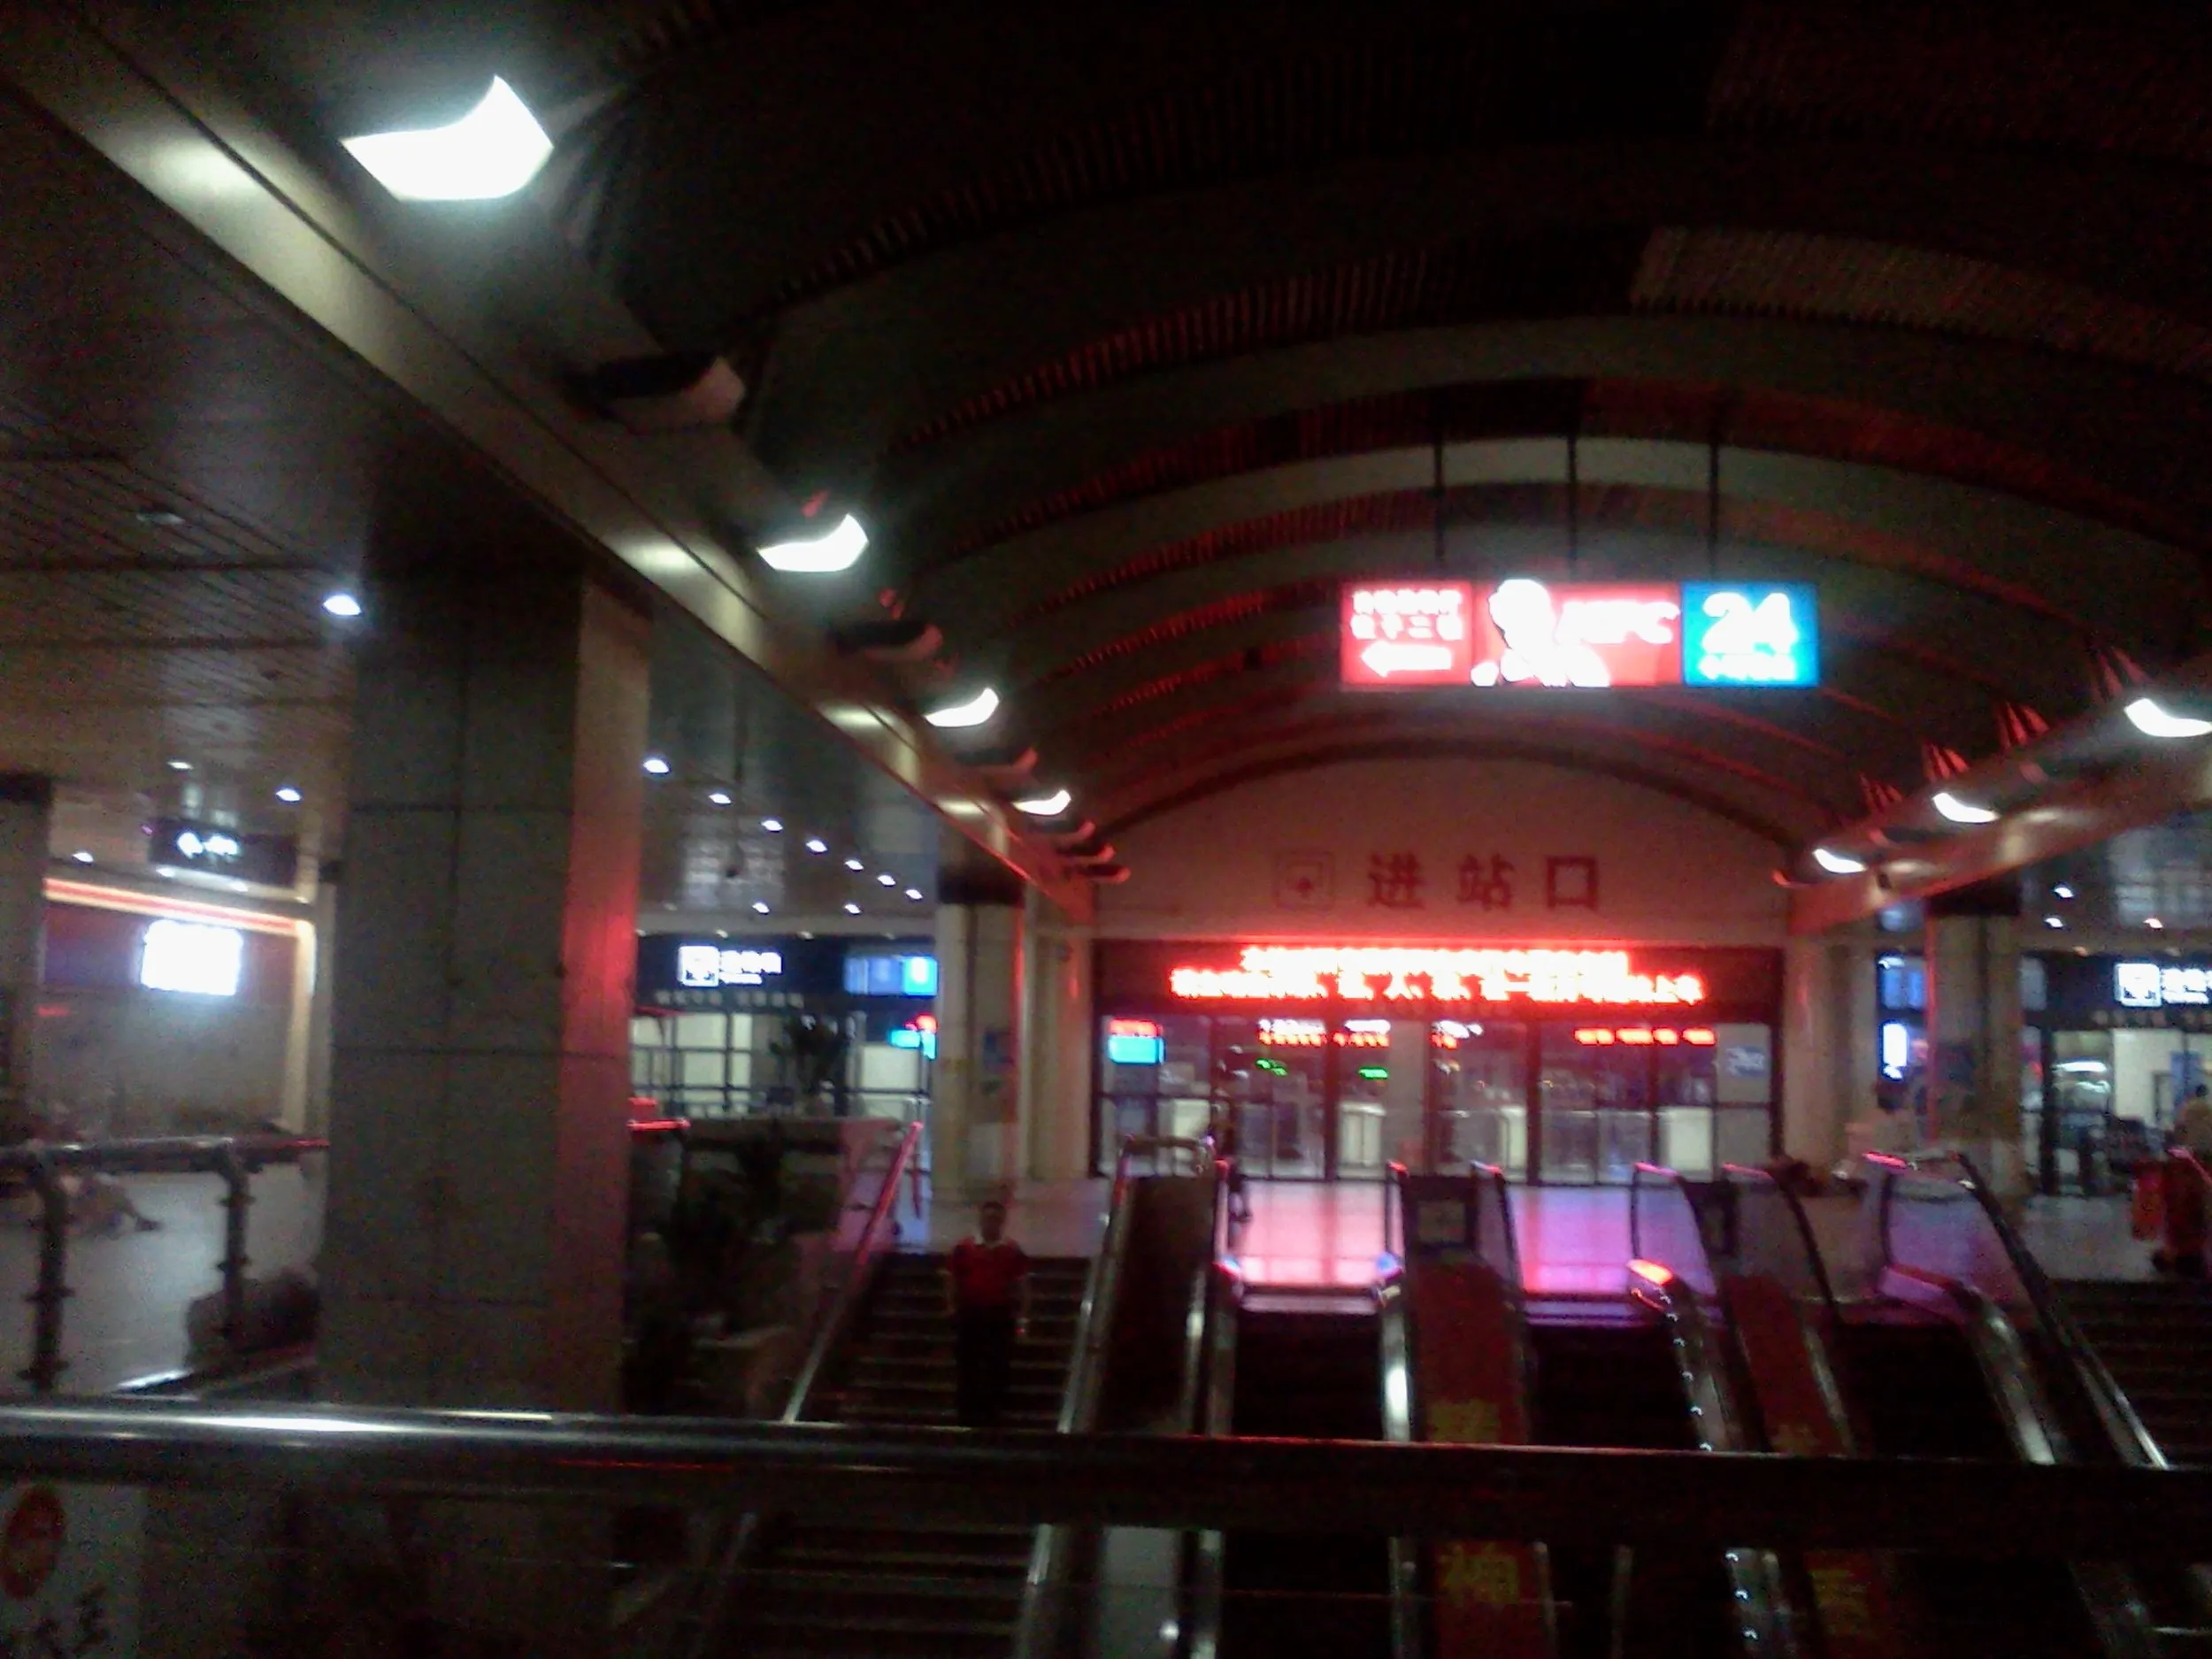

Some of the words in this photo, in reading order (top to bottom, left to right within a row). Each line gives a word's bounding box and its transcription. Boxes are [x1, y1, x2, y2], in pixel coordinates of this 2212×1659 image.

[1701, 592, 1800, 653] 24
[1367, 851, 1601, 911] 进站口
